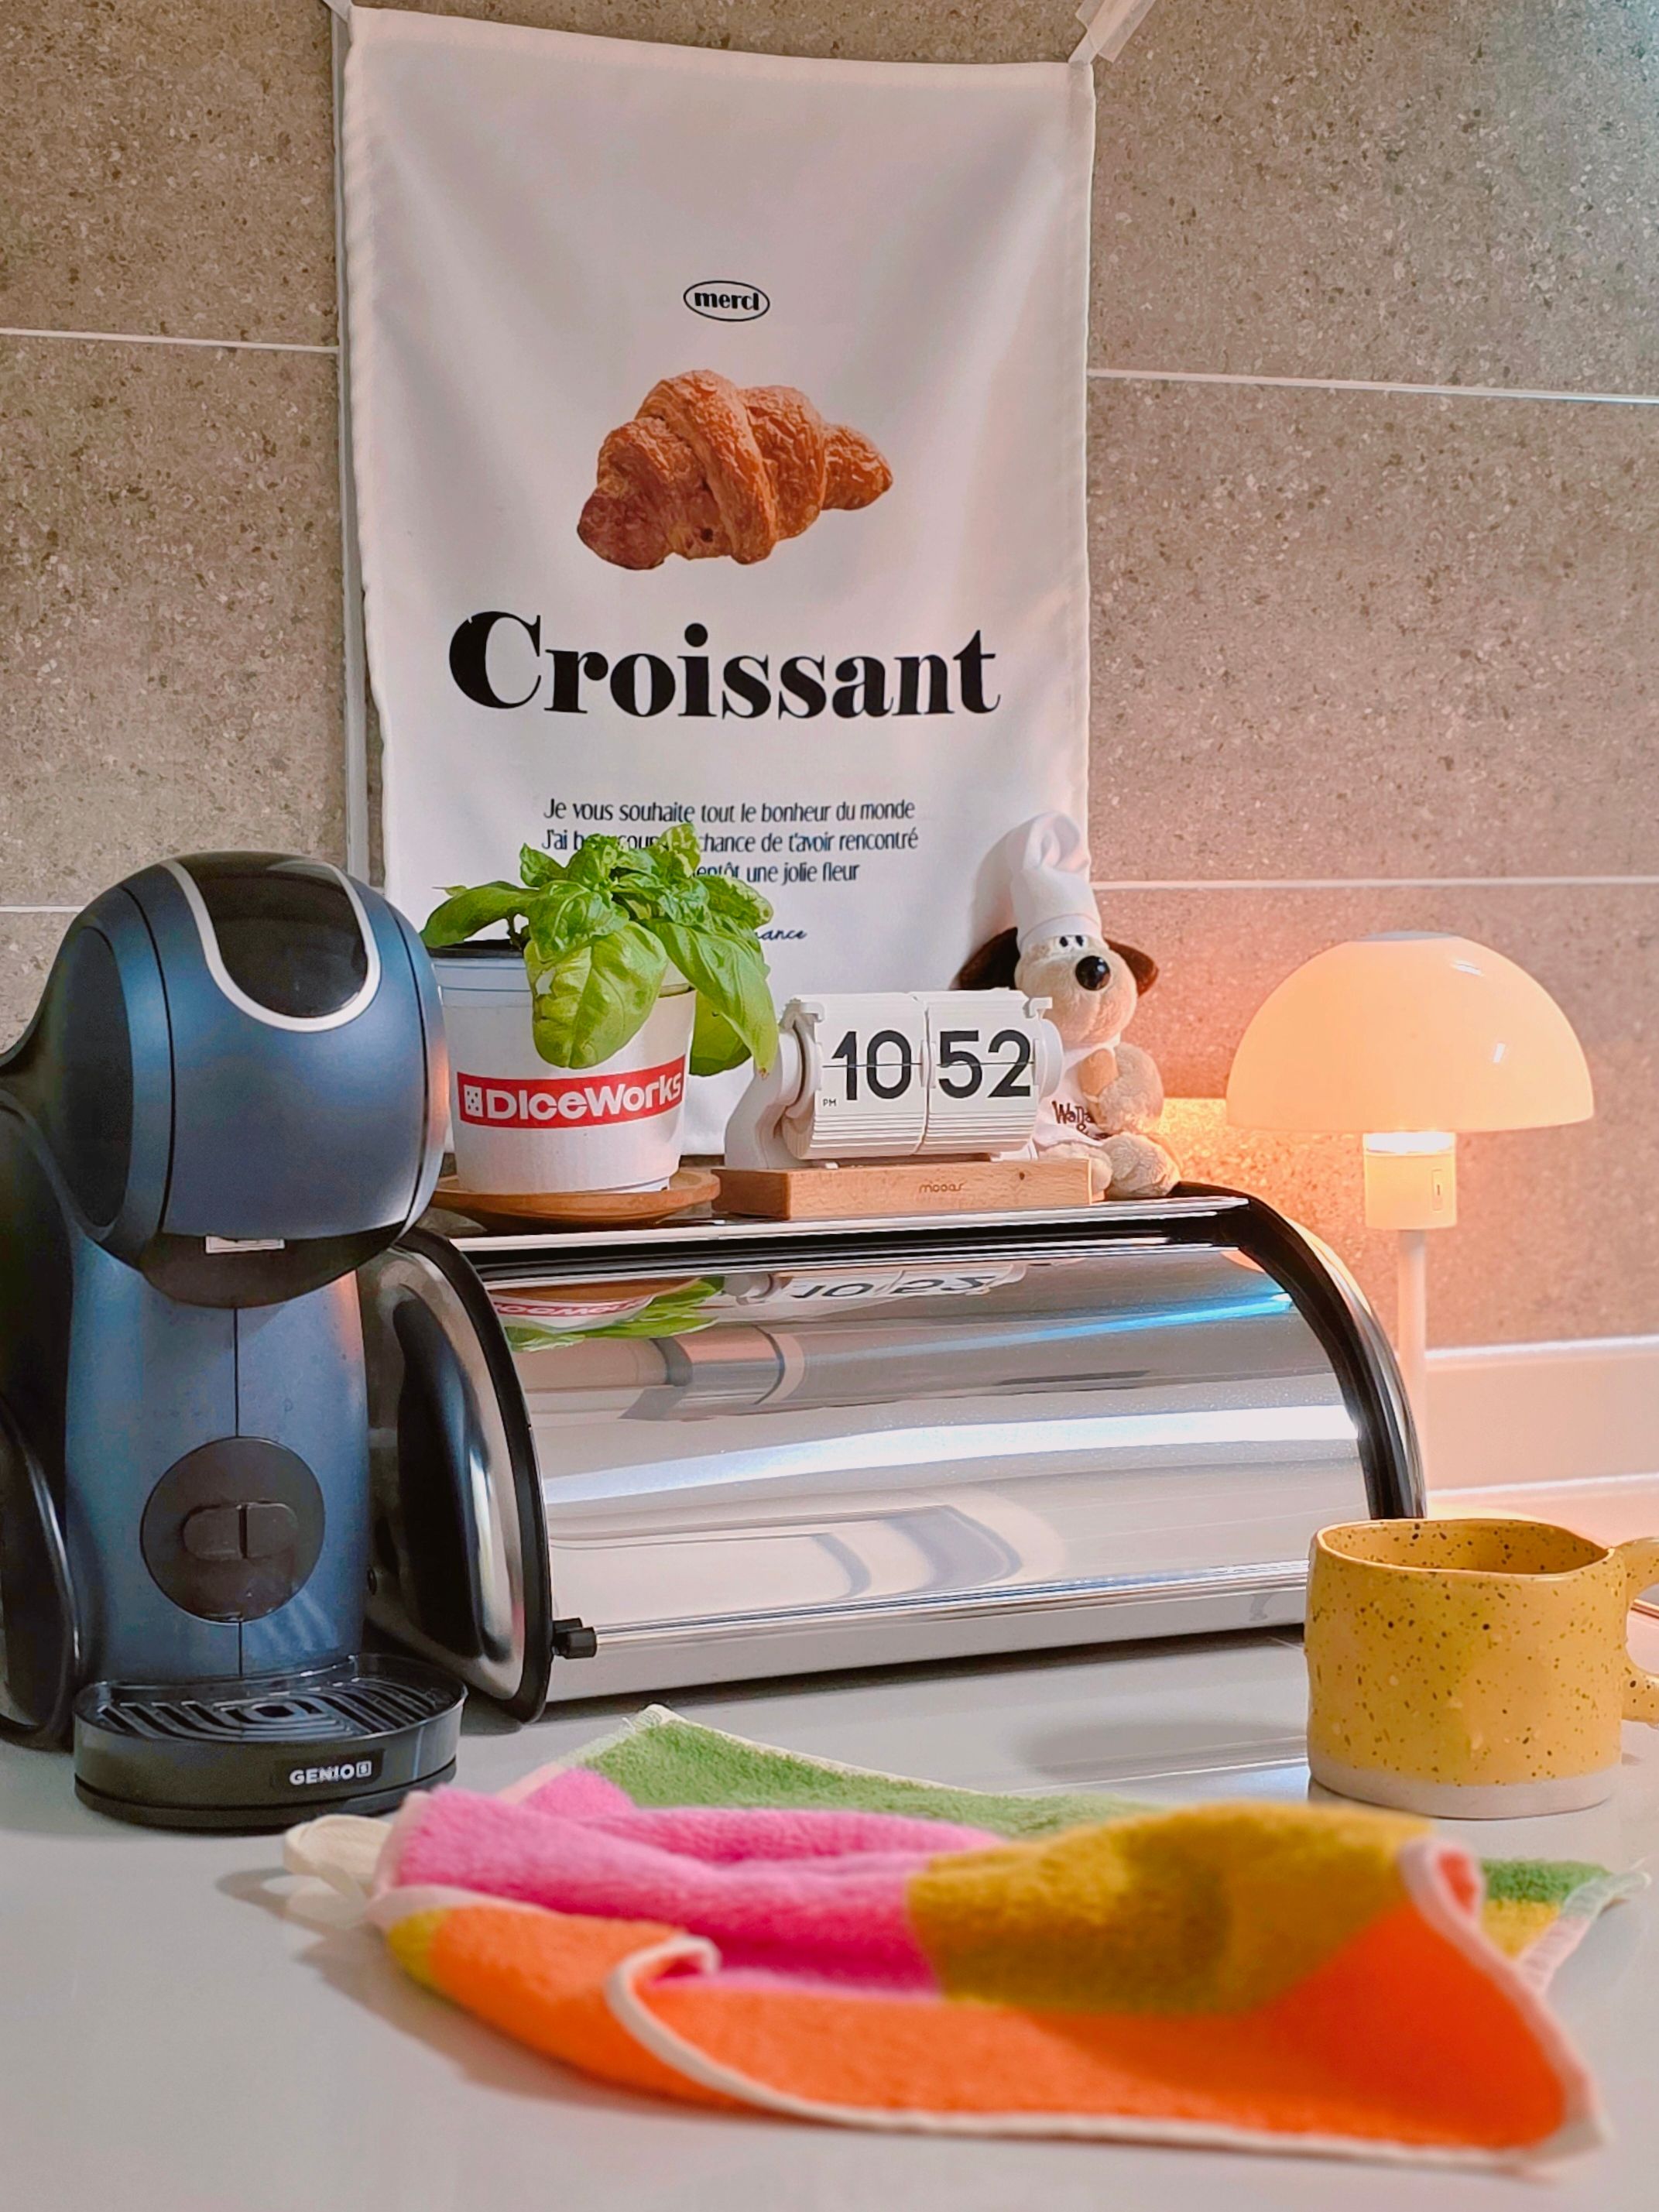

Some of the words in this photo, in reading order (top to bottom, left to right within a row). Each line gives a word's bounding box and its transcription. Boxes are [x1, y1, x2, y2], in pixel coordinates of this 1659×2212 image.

[449, 610, 1001, 720] Croissant
[543, 798, 567, 819] Je
[573, 803, 614, 821] vous
[619, 801, 695, 823] souhaite
[701, 804, 735, 823] tout
[741, 802, 757, 823] le
[761, 802, 831, 823] bonheur
[836, 801, 856, 821] du
[860, 800, 915, 820] monde
[542, 828, 568, 850] J'ai
[761, 832, 783, 852] de
[789, 832, 835, 852] t'avoir
[839, 827, 919, 851] rencontré
[747, 866, 779, 883] une
[782, 862, 818, 886] jolie
[823, 862, 860, 882] fleur
[831, 1029, 913, 1101] 10
[938, 1029, 1033, 1099] 52
[823, 1098, 836, 1107] PM
